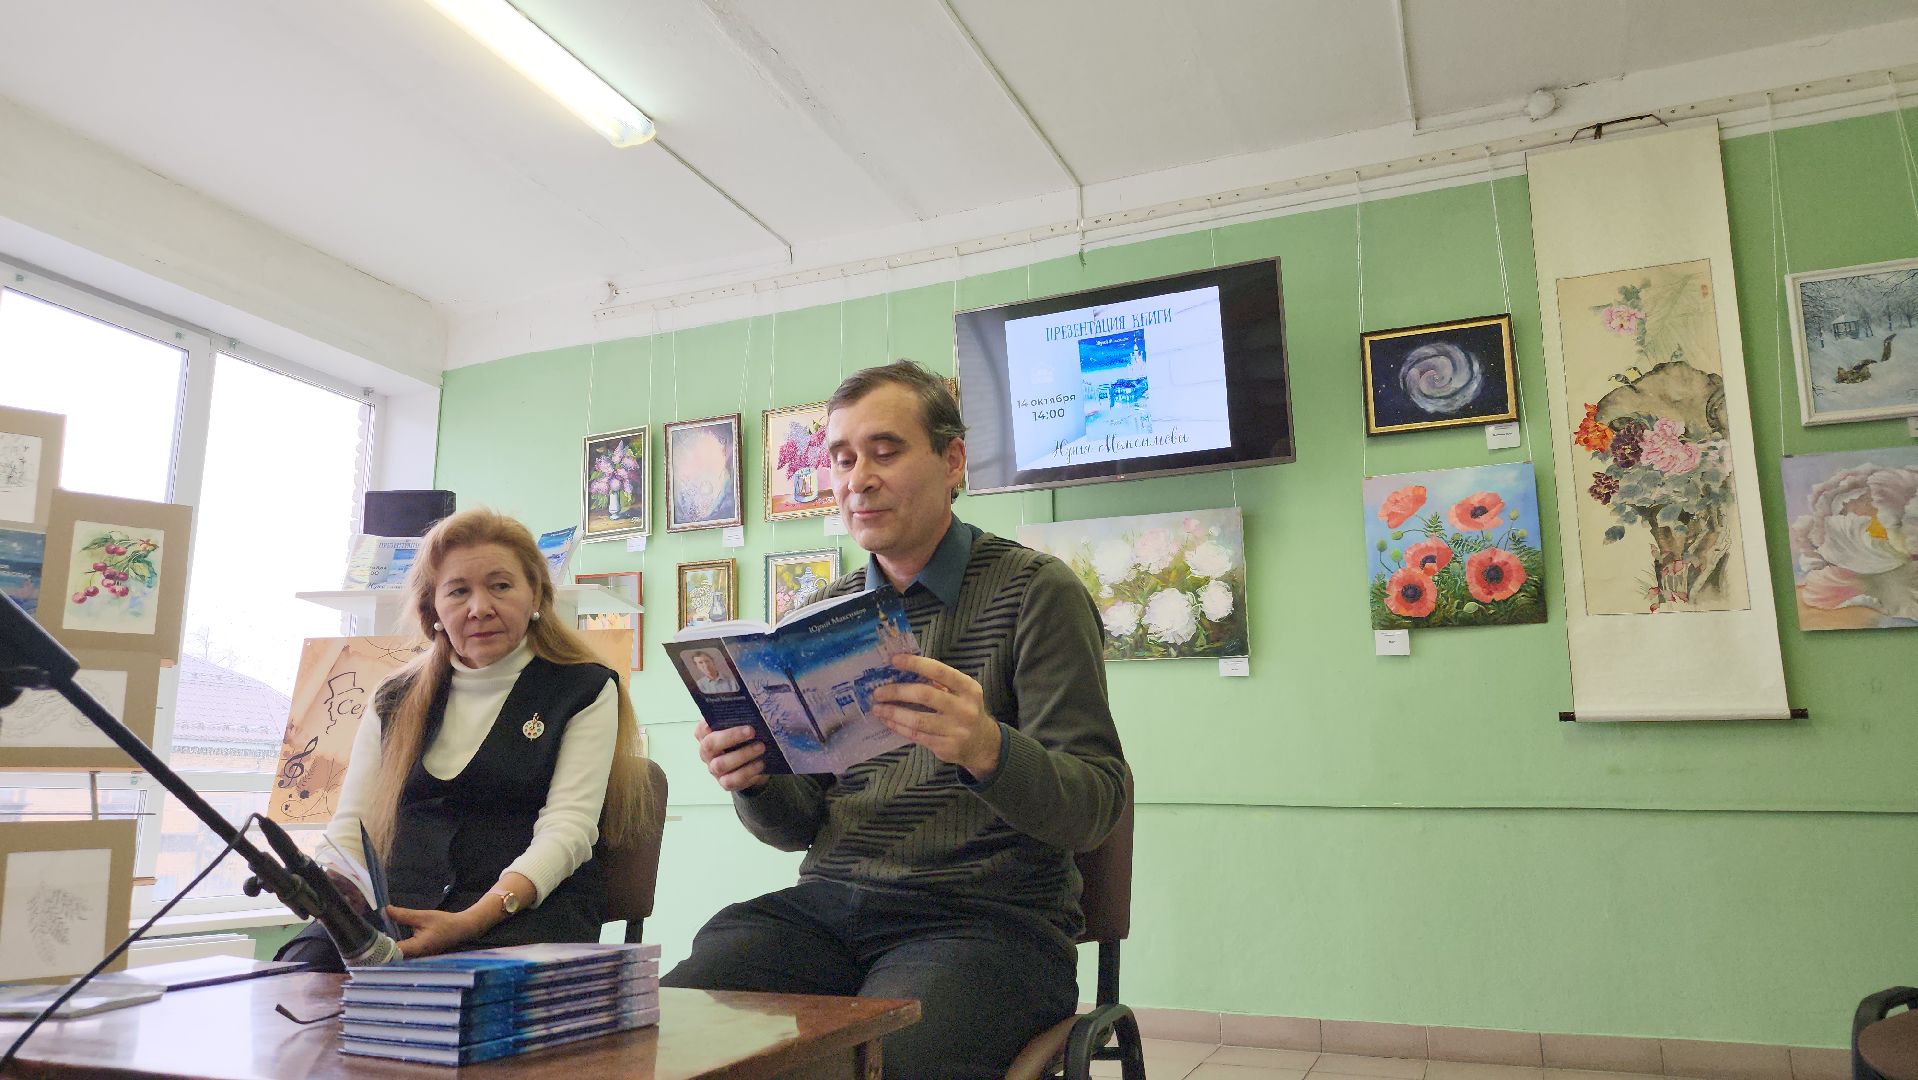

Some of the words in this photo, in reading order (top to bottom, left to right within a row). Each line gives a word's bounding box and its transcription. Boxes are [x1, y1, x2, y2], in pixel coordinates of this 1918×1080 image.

[1046, 315, 1126, 341] ПРЕЗЕНТАЦИЯ
[1132, 308, 1172, 329] КНИГИ
[1017, 400, 1028, 408] 14
[1030, 393, 1076, 407] октября
[1032, 408, 1065, 421] 14:00
[1053, 439, 1091, 464] Юрия
[1098, 426, 1191, 454] Максимова
